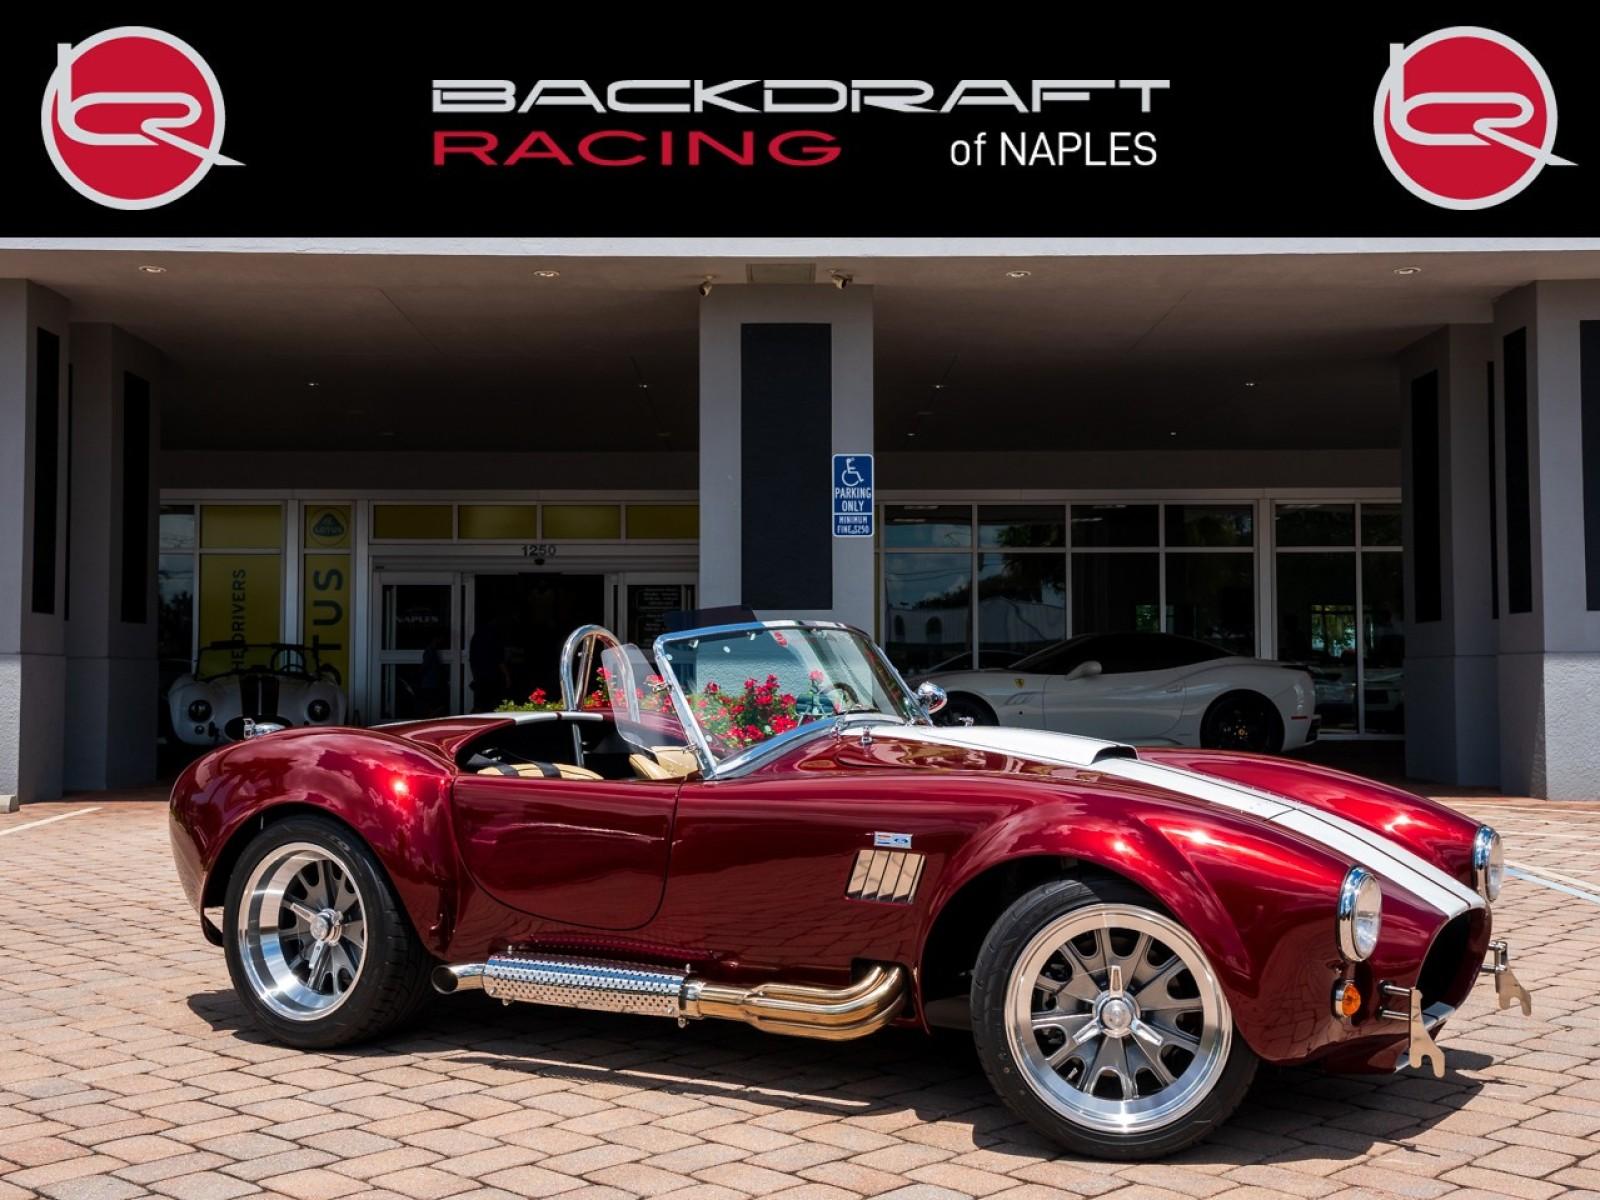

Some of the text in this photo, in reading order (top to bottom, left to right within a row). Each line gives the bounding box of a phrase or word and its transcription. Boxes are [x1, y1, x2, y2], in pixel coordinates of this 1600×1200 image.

[835, 487, 872, 499] PARKING
[841, 500, 864, 512] ONLY
[521, 544, 556, 557] 1250
[232, 568, 246, 643] DRIVERS
